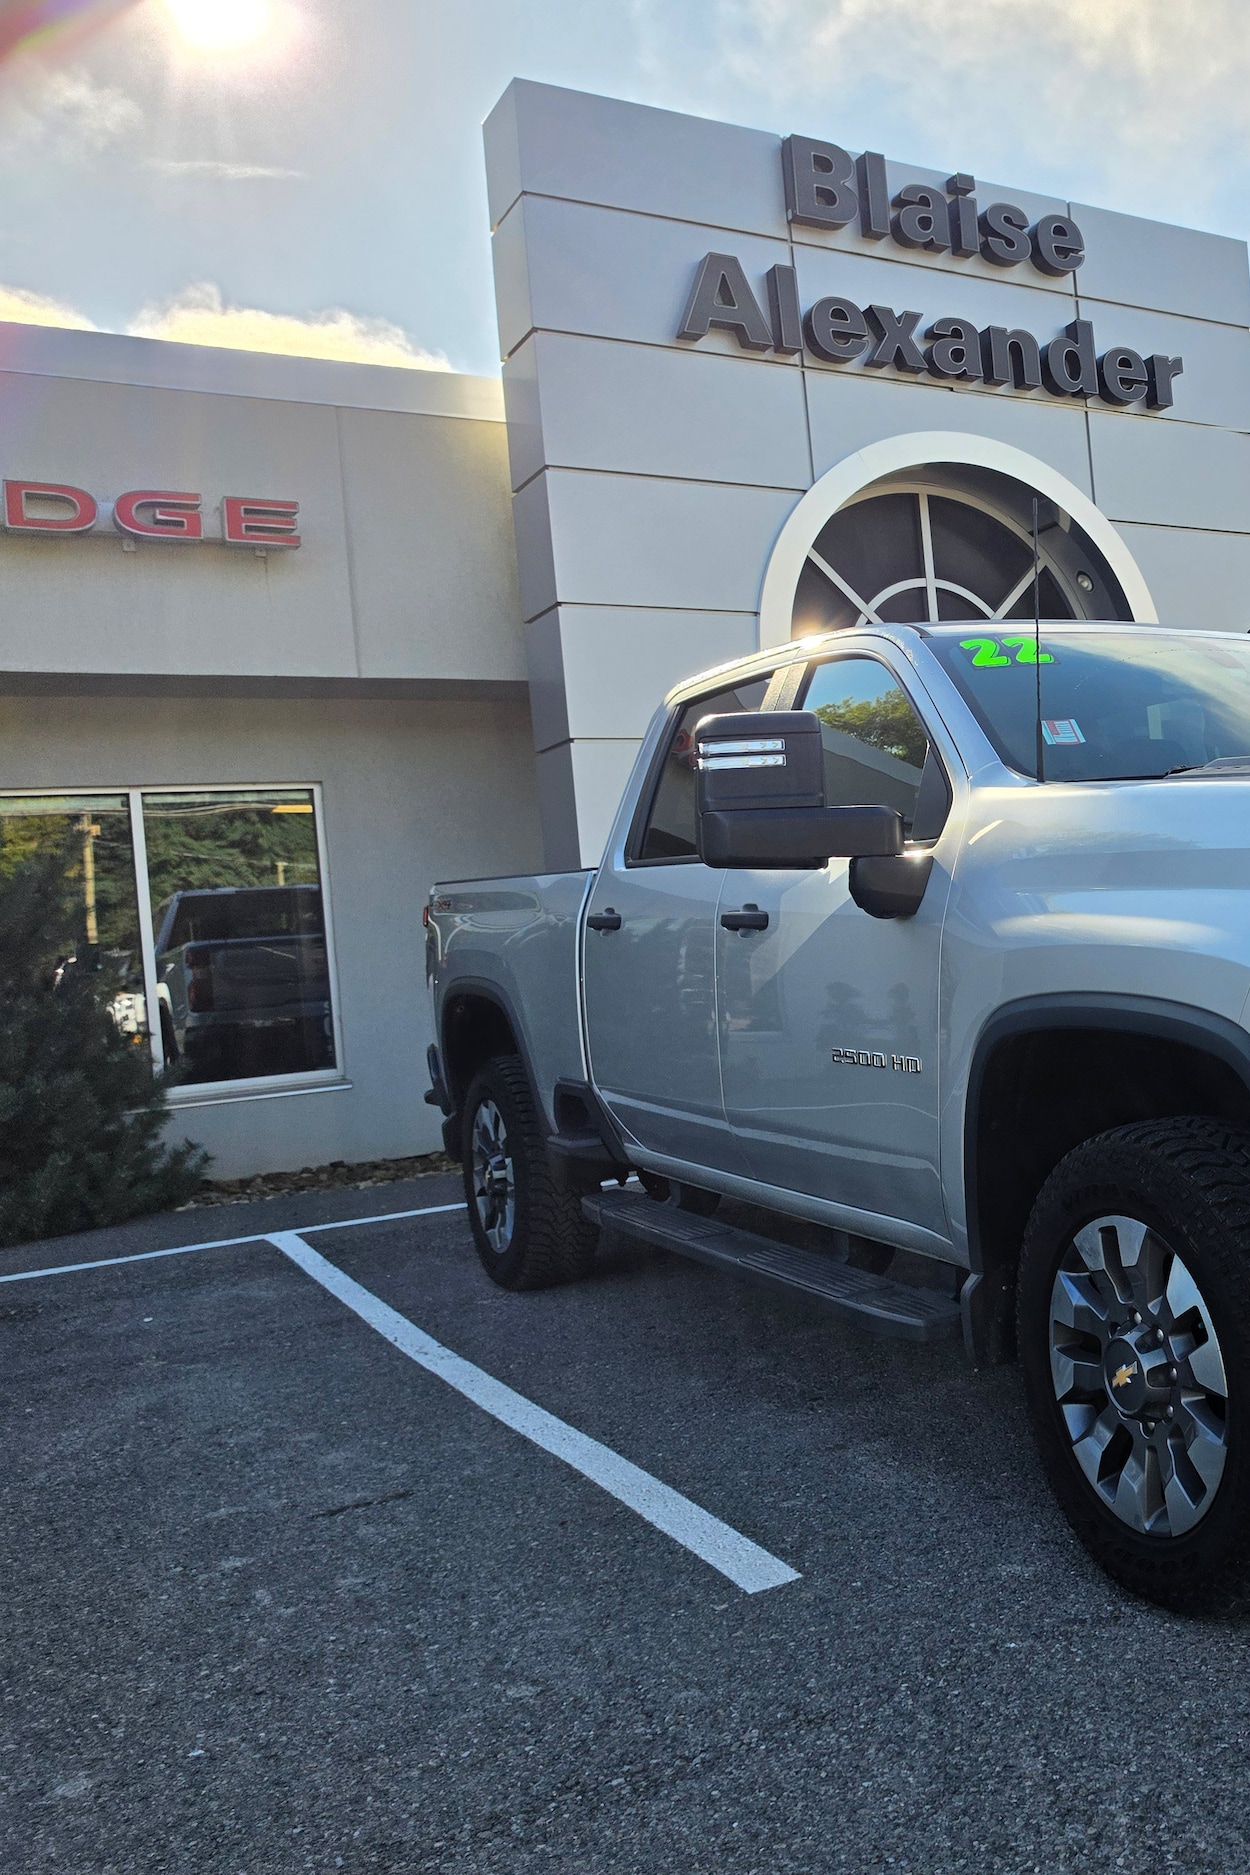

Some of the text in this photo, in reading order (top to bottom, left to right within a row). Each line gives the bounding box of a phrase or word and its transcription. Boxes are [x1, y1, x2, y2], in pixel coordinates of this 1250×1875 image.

[782, 134, 1085, 277] Blaise
[676, 252, 1183, 411] Alexander
[960, 637, 1054, 668] 22
[831, 1047, 923, 1074] 2500 HD
